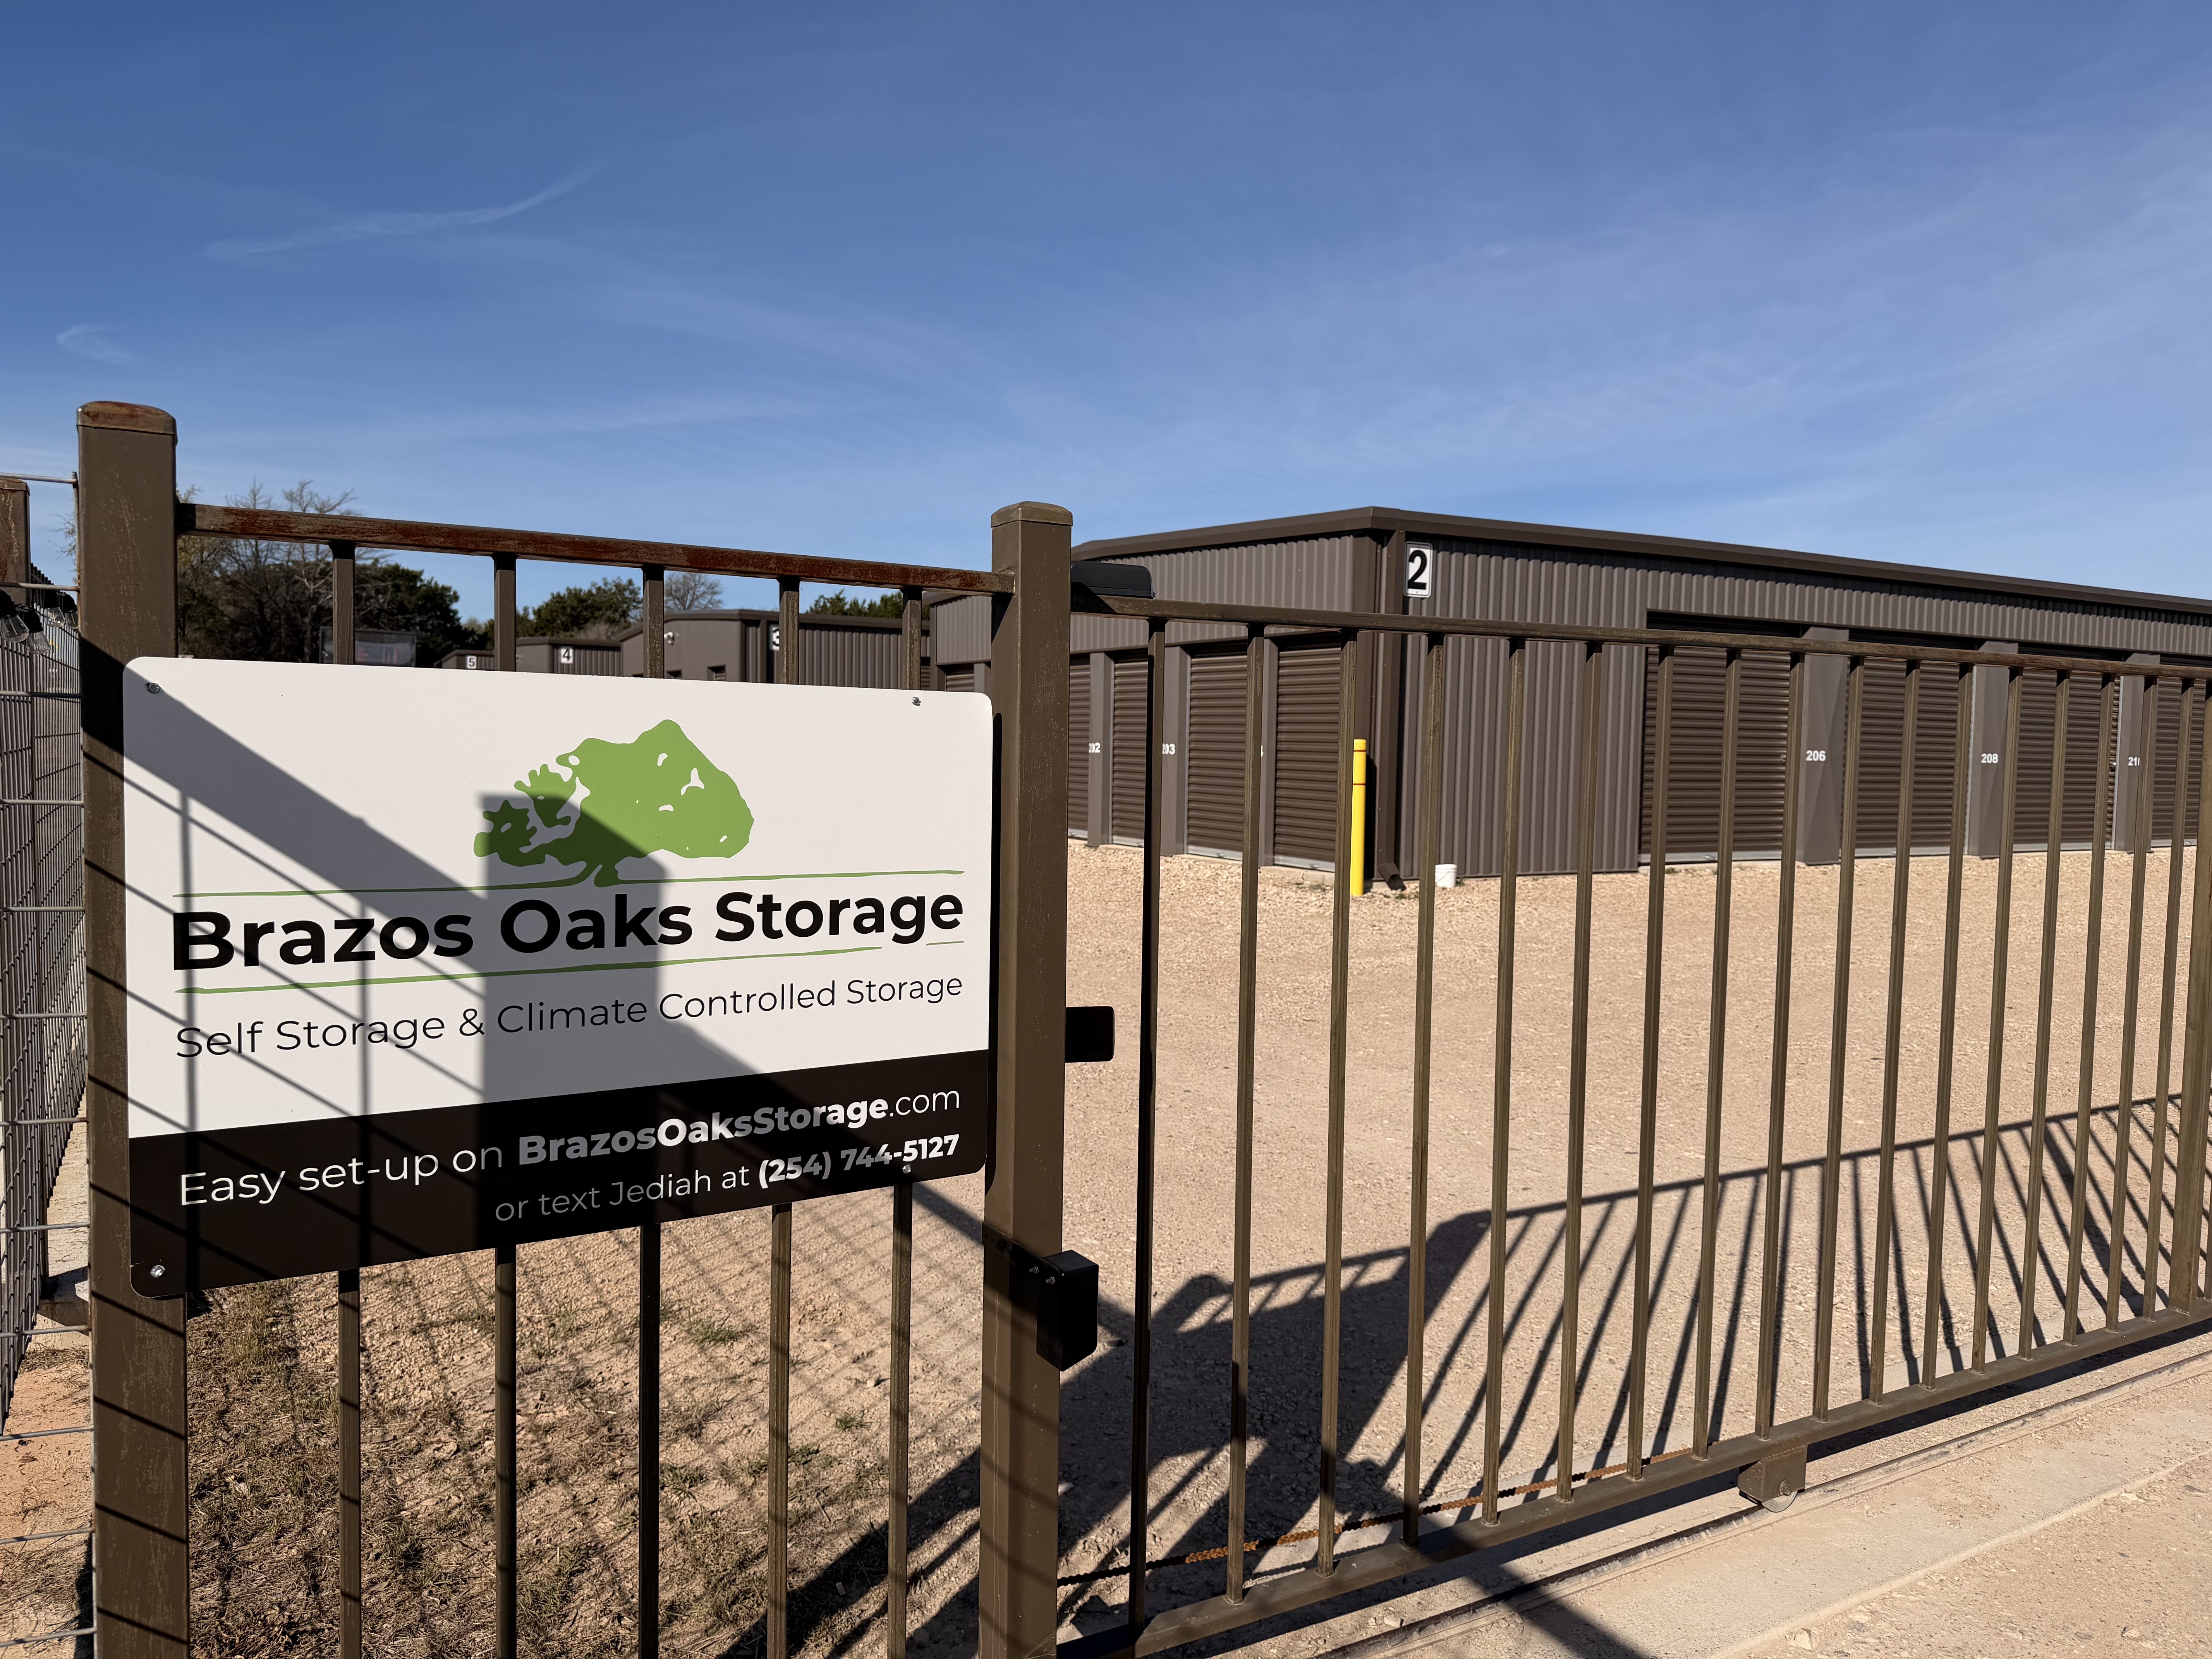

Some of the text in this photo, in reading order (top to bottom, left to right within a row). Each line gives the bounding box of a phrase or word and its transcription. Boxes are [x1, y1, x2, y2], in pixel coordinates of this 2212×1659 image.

[1407, 549, 1427, 591] 2
[773, 628, 780, 647] 3
[469, 658, 475, 667] 5
[563, 647, 572, 661] 4
[1805, 750, 1826, 762] 206
[1981, 753, 1999, 764] 208
[172, 891, 963, 971] Brazos Oaks Storage
[176, 978, 962, 1058] Self Storage & Climate Controlled Storage
[180, 1090, 960, 1206] Easy set-up on BrazosOaksStorage.com
[495, 1133, 960, 1221] or text Jediah at (254) 744-5127
